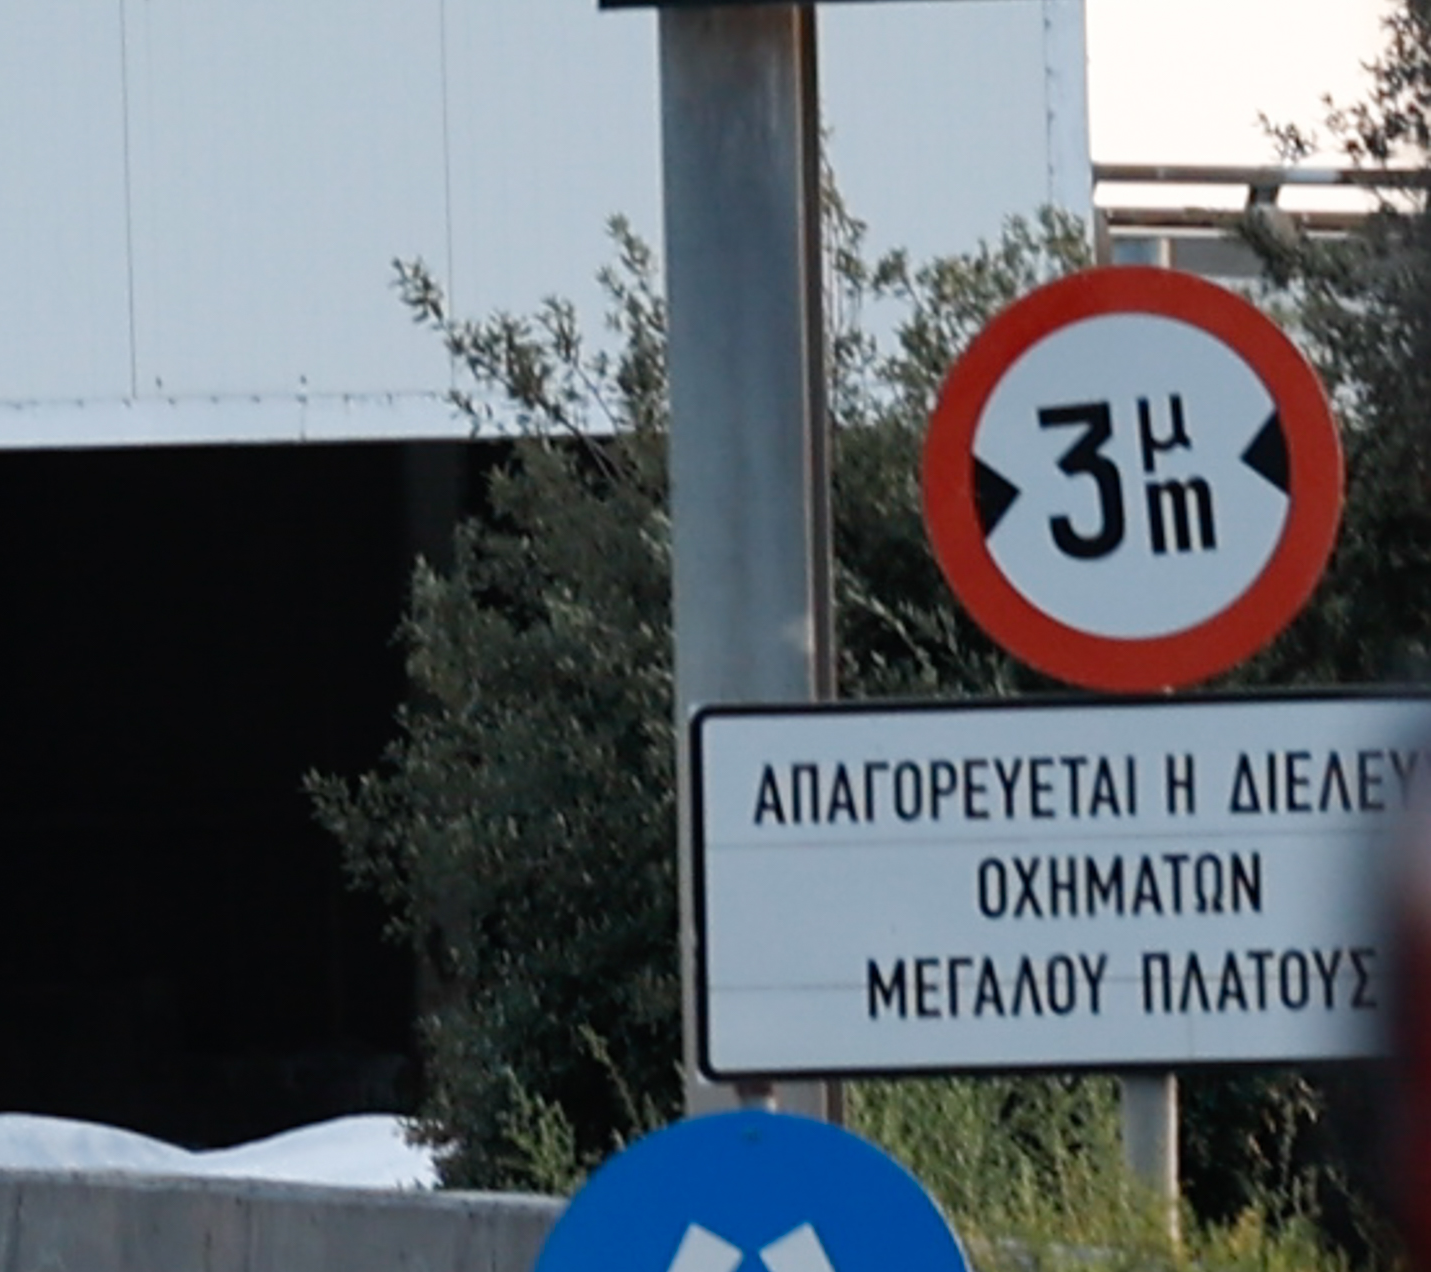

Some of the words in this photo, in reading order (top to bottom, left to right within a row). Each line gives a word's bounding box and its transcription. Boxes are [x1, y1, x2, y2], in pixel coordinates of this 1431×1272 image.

[1037, 400, 1126, 562] 3
[1145, 475, 1218, 555] m
[753, 755, 1137, 826] ΑΠΑΓΟΡΕΥΕΤΑΙ
[1165, 753, 1195, 815] Η
[1228, 747, 1431, 815] ΔΙΕΛΕΥ
[977, 851, 1262, 919] ΟΧΗΜΑΤΩΝ
[866, 953, 1108, 1020] ΜΕΓΑΛΟΥ
[1141, 947, 1379, 1016] ΠΛΑΤΟΥΣ
